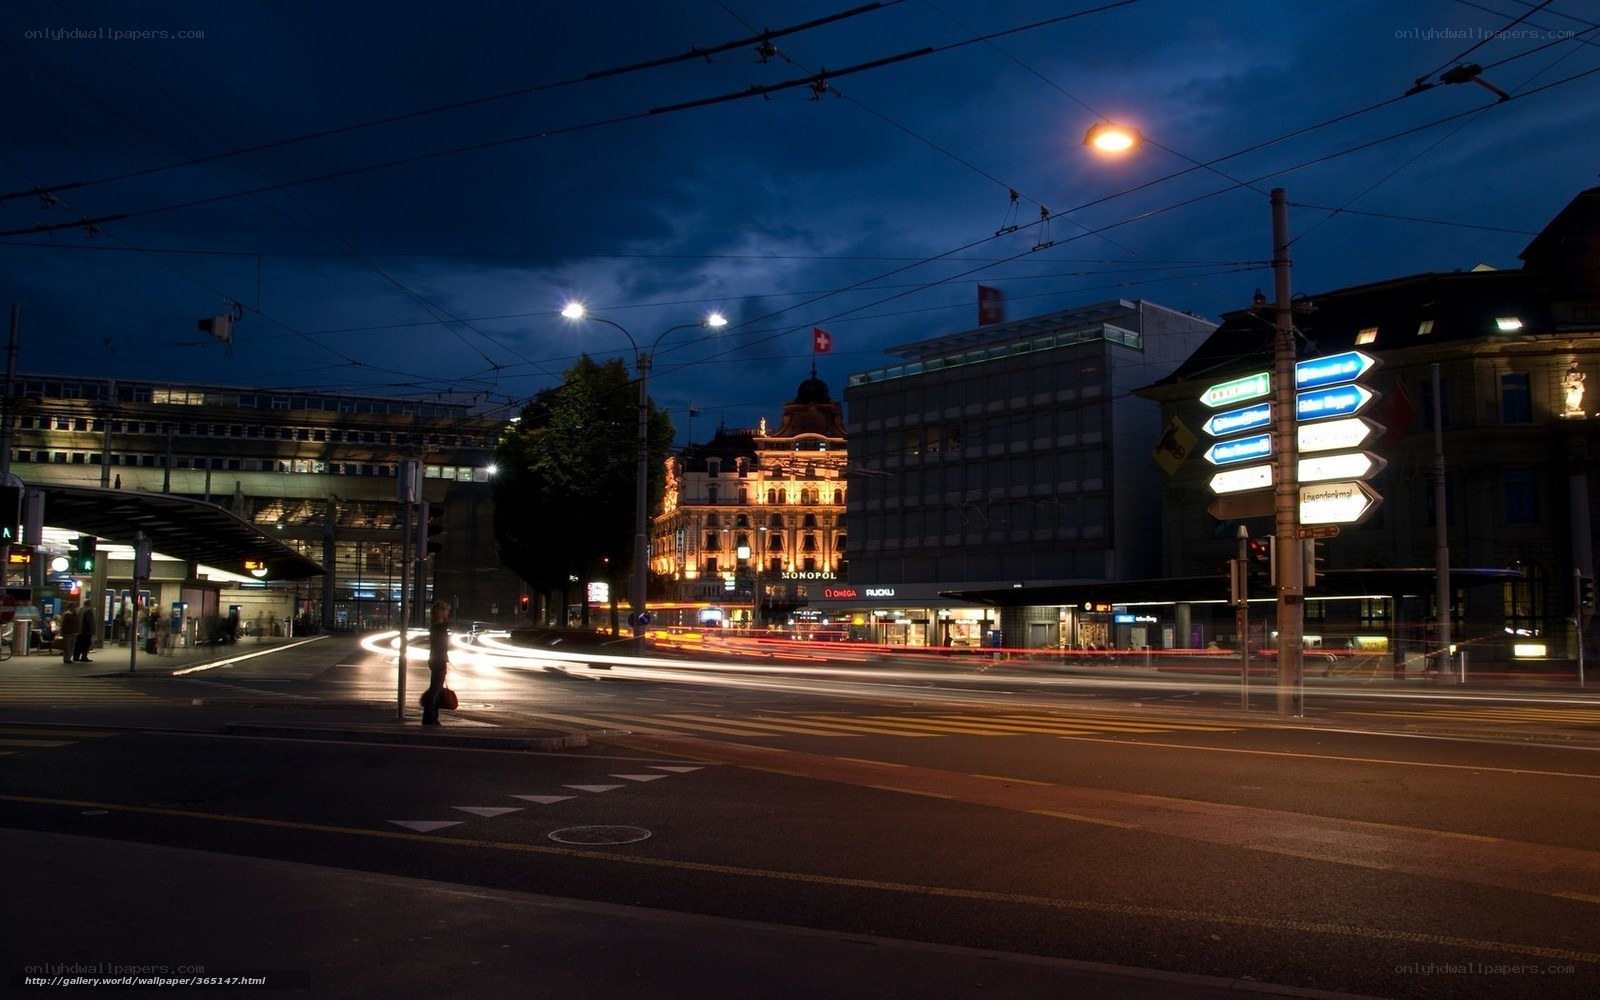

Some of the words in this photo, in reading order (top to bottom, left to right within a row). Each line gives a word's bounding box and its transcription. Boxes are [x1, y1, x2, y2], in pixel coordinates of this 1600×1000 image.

[1303, 489, 1353, 504] Löwendenkmal
[782, 571, 837, 580] MONOPOL
[833, 589, 857, 598] OMEGA
